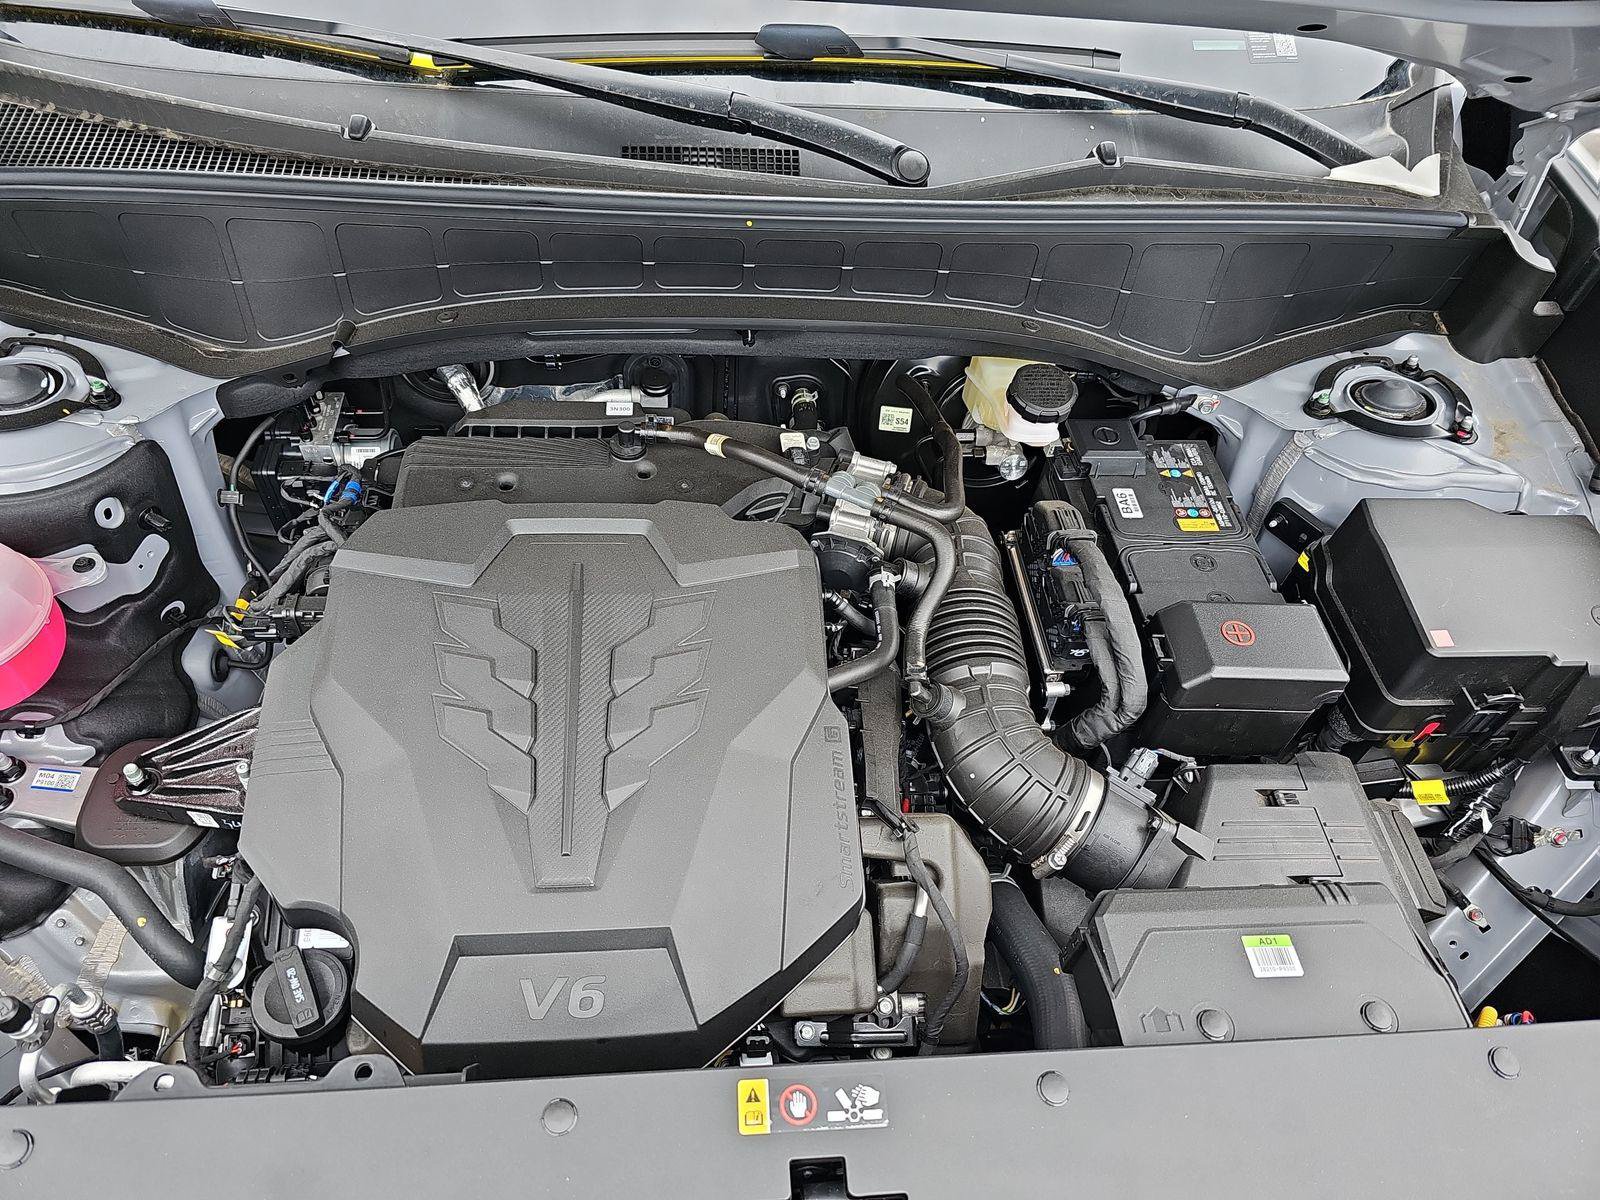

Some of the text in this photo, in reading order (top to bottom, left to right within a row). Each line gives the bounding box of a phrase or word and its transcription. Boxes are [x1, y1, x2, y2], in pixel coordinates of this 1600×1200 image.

[1116, 492, 1134, 514] BA6
[832, 750, 854, 892] Smartstream
[292, 987, 306, 1004] SAE
[519, 975, 607, 1020] V6
